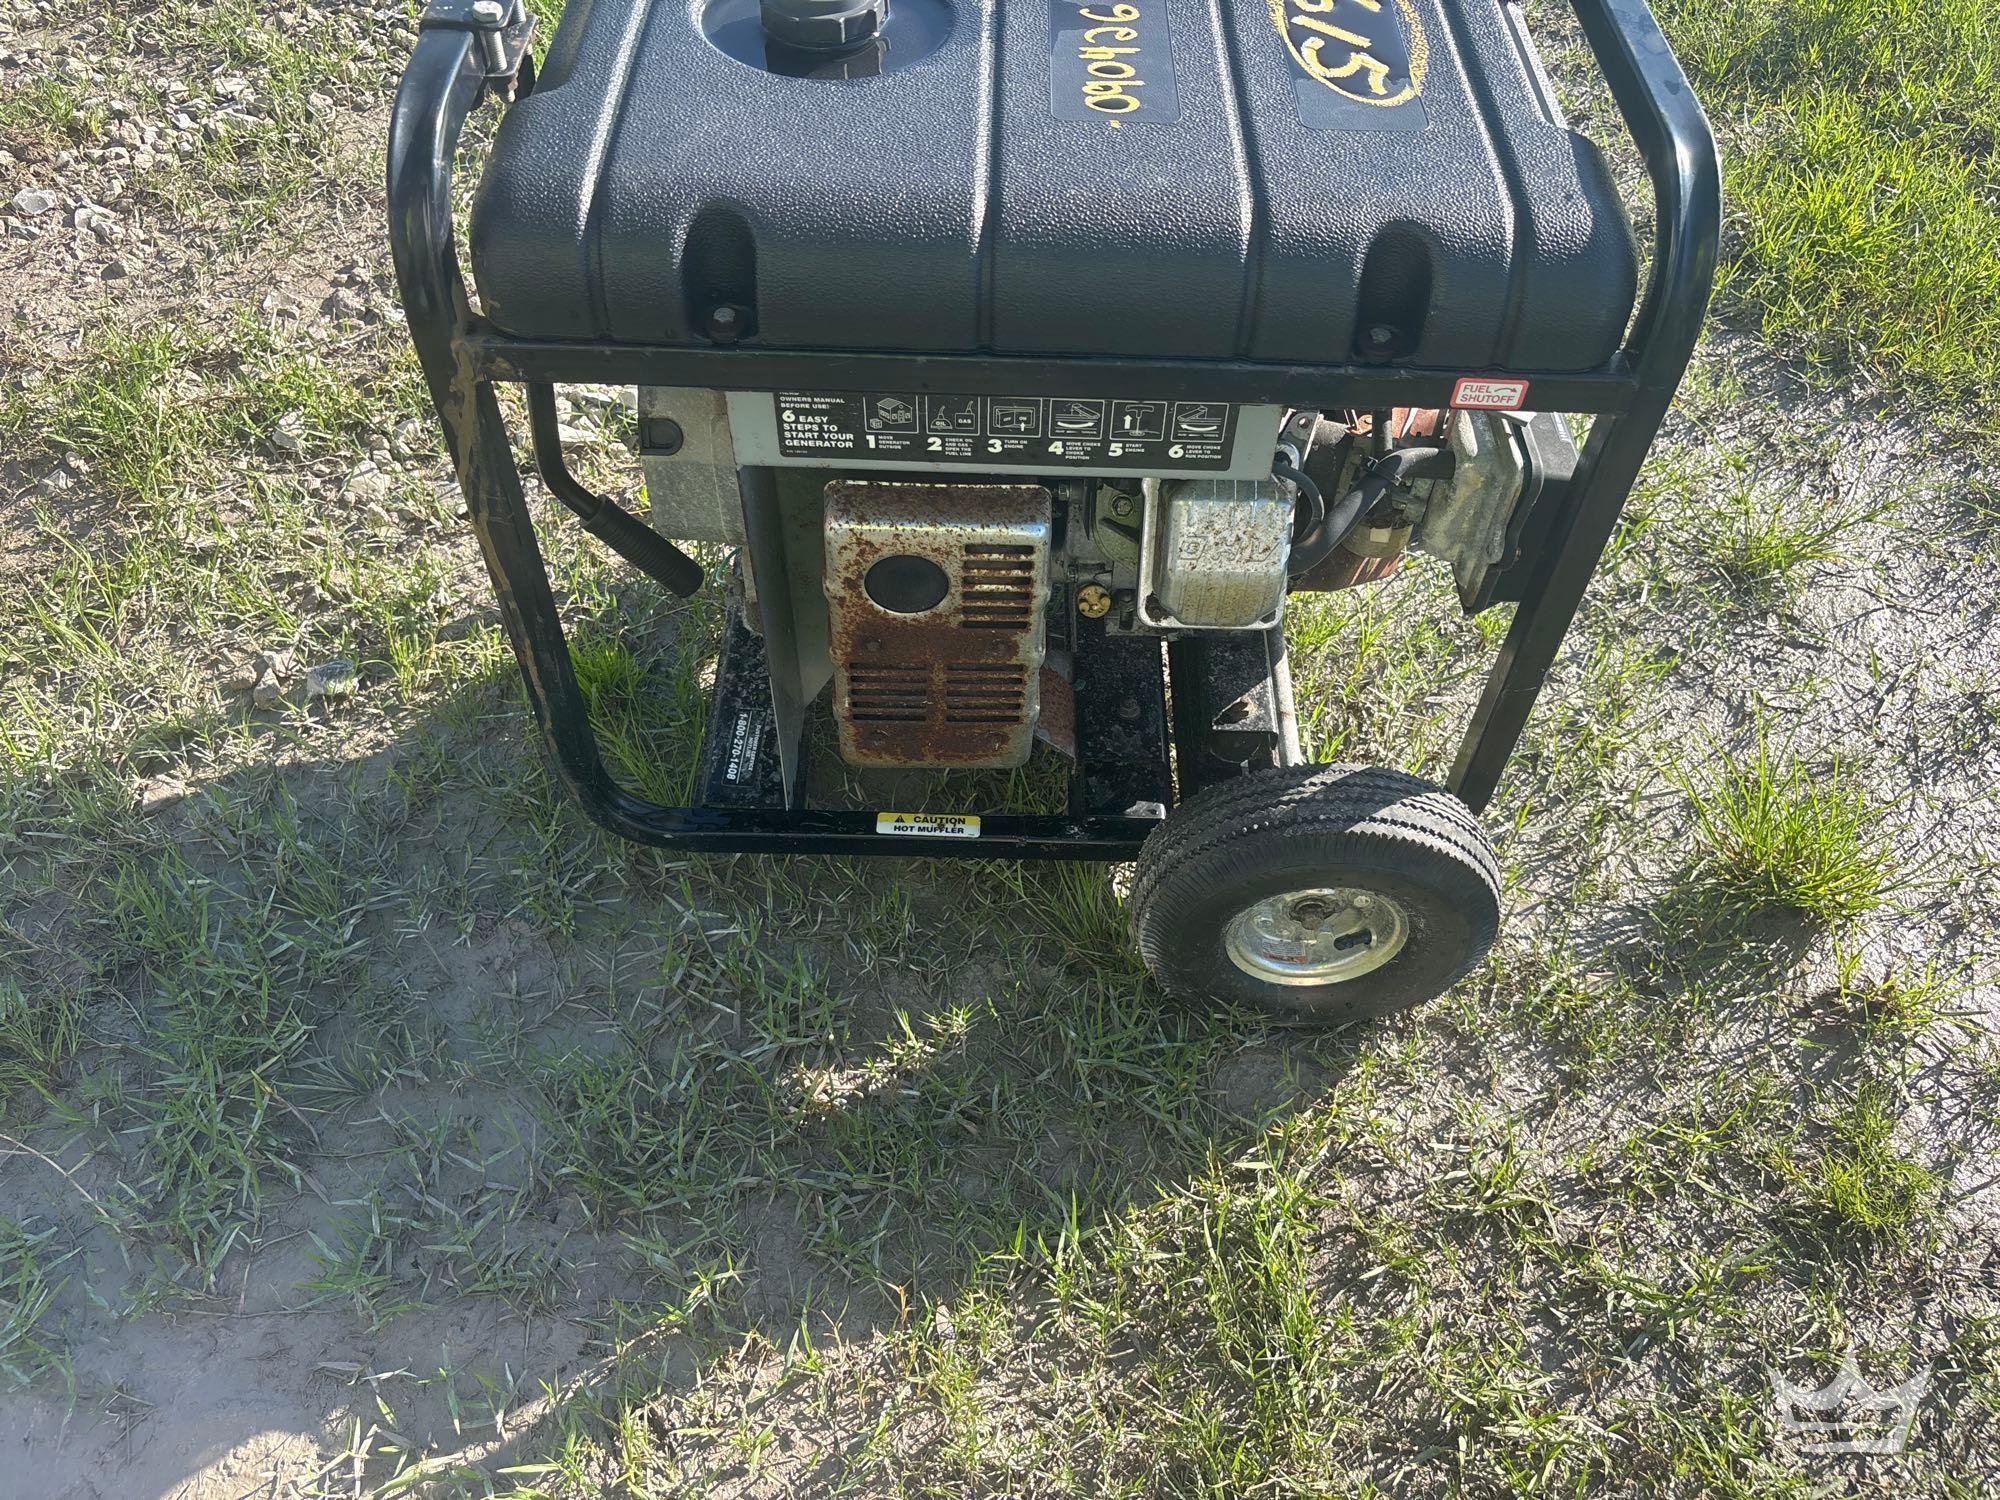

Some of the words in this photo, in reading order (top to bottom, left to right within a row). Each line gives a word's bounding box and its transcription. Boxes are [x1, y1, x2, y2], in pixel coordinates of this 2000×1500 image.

[1463, 384, 1492, 394] FUEL
[1460, 394, 1515, 404] SHUTOFF
[782, 410, 796, 422] 6
[822, 432, 854, 440] YOUR
[866, 435, 876, 449] 1
[785, 440, 854, 448] GENERATOR
[927, 437, 942, 451] 2
[987, 439, 1002, 453] 3
[1048, 440, 1064, 455] 4
[1108, 442, 1123, 457] 5
[1168, 444, 1184, 459] 6
[726, 713, 748, 780] 1-800-270-1408
[913, 816, 966, 825] CAUTION
[918, 826, 965, 834] MUFFLER
